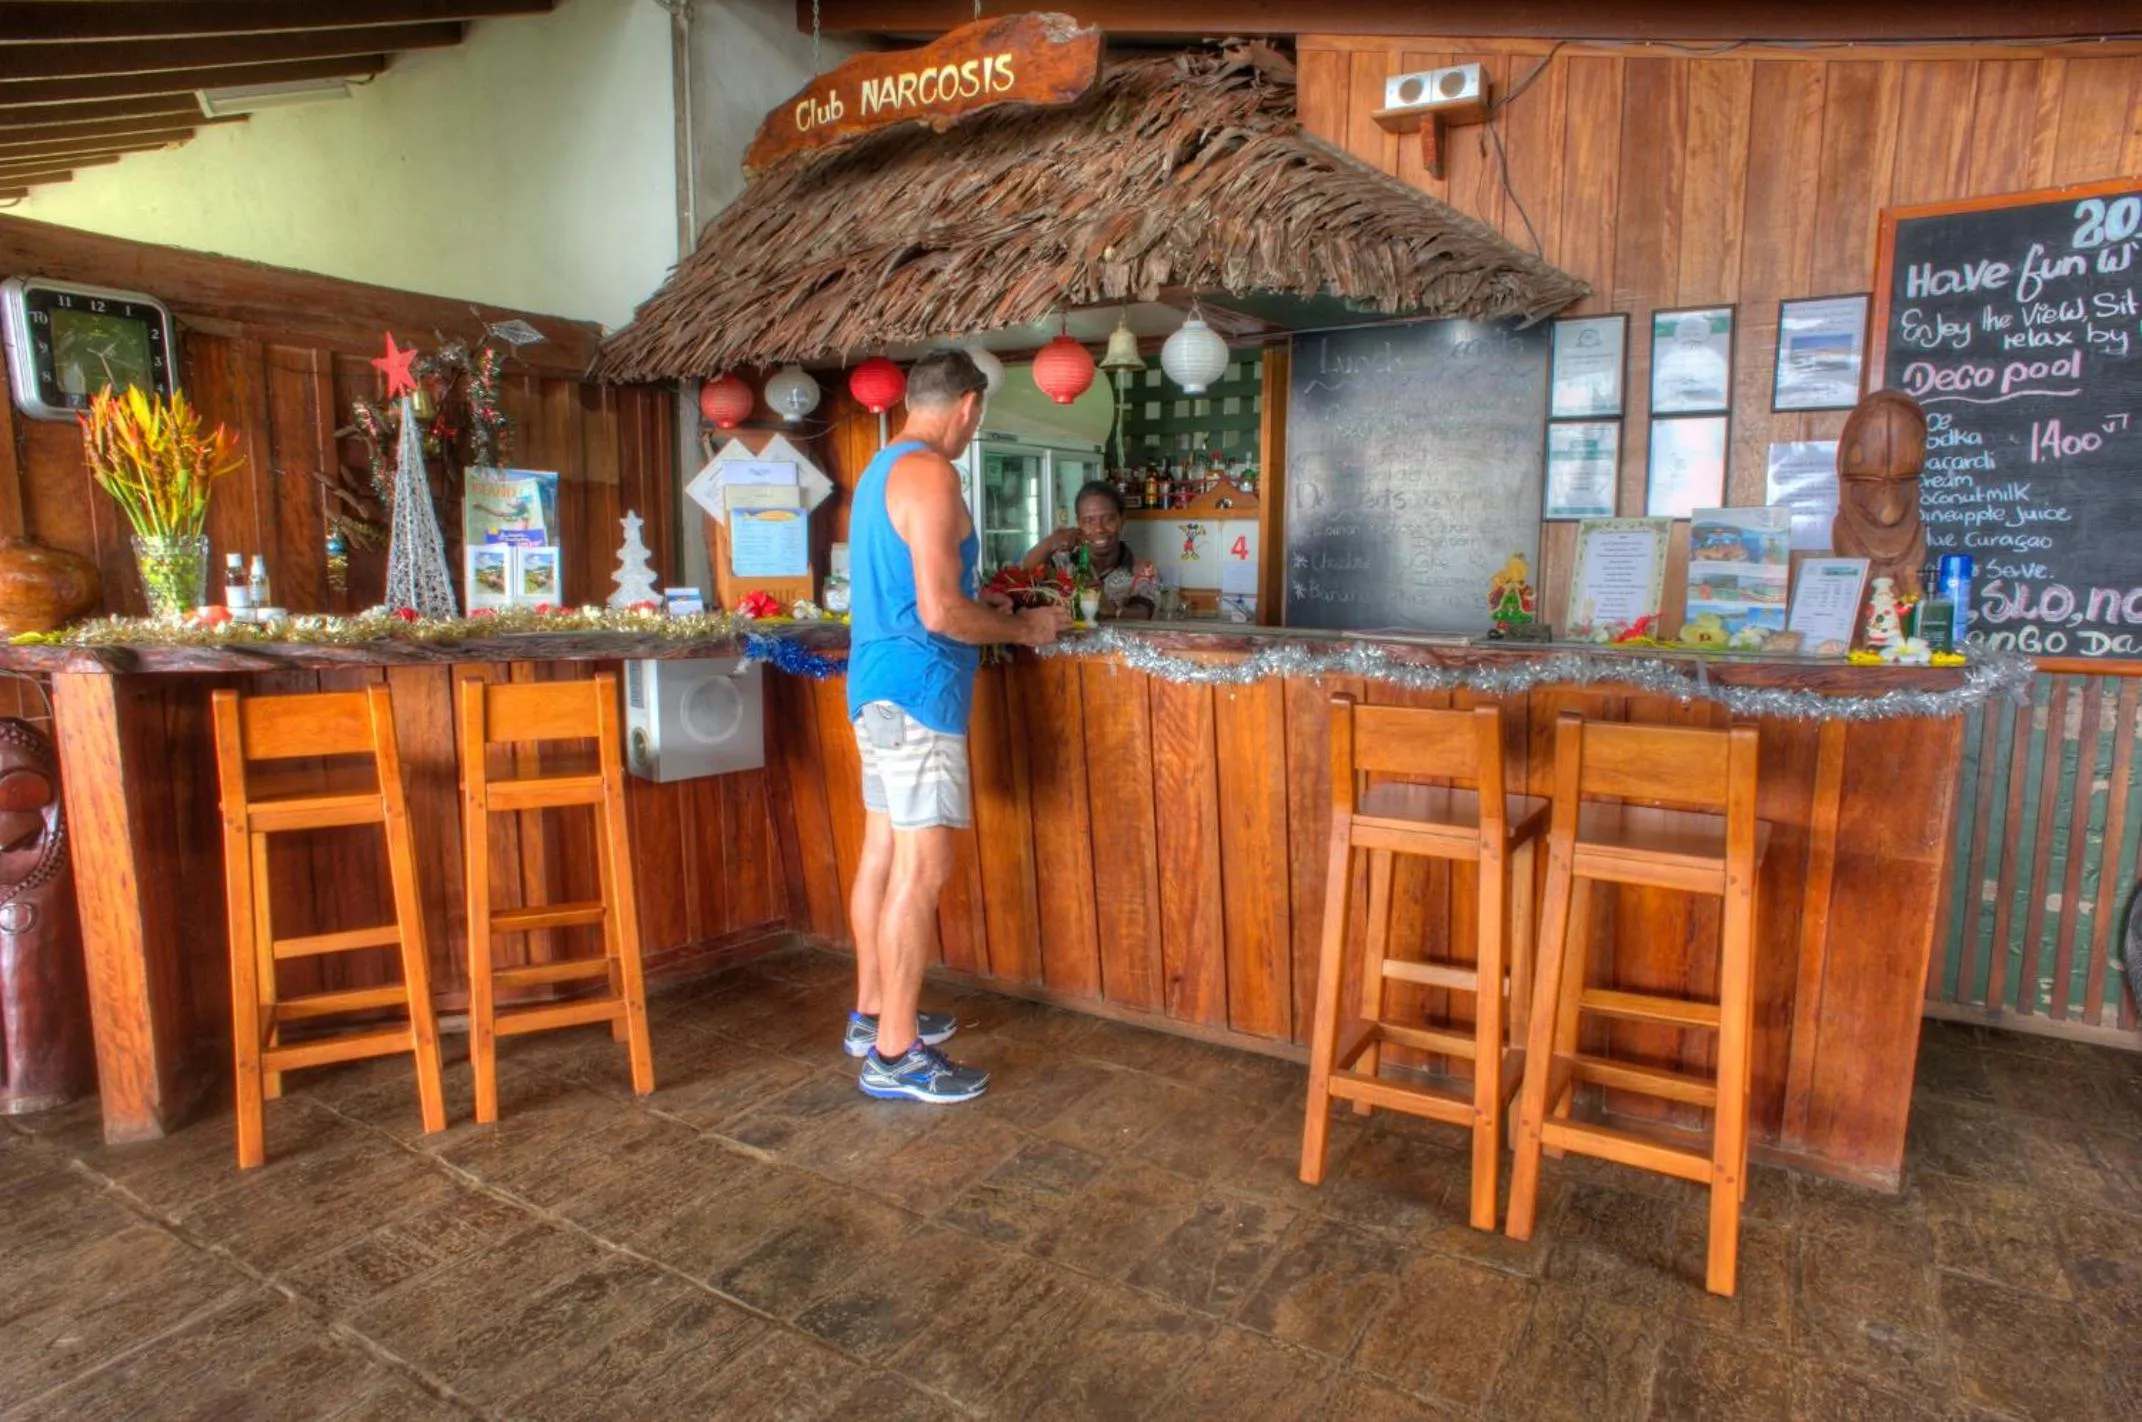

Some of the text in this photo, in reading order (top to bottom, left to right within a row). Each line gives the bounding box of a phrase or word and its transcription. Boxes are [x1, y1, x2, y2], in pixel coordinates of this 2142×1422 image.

[796, 53, 1014, 132] Club NARCOSIS
[2072, 196, 2142, 249] 20
[1907, 259, 2009, 298] Have
[2017, 243, 2086, 303] fun
[57, 295, 72, 308] 11
[90, 300, 106, 313] 12
[125, 305, 132, 317] 1
[2093, 287, 2139, 317] Sit
[150, 329, 160, 340] 2
[2004, 321, 2129, 356] relax by
[154, 356, 163, 367] 3
[2001, 349, 2082, 394] pool
[1926, 427, 1983, 449] odka
[1925, 450, 1996, 470] acardi
[1919, 472, 1974, 488] ream
[1919, 486, 1984, 505] oconut
[1231, 534, 1249, 560] 4
[1926, 526, 1958, 548] lue
[2076, 630, 2142, 657] Da
